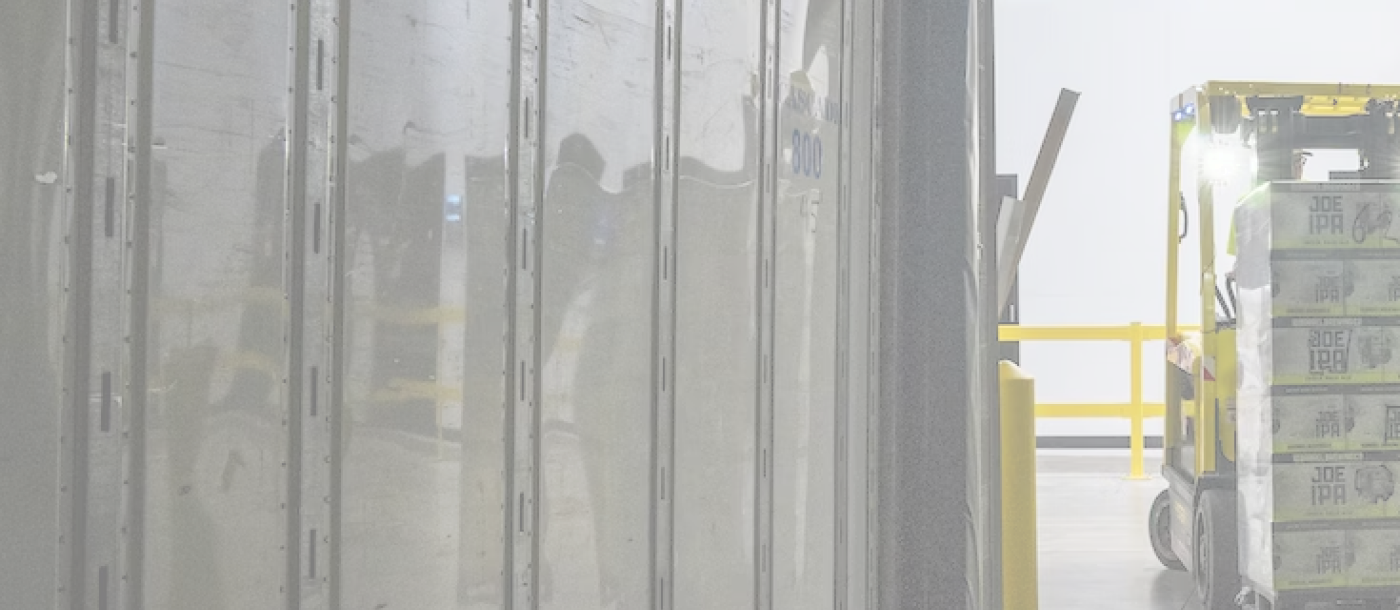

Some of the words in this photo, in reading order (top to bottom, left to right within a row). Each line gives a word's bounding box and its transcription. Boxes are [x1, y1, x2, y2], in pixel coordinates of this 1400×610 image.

[791, 128, 823, 179] 800
[1309, 195, 1343, 212] JOE
[1309, 214, 1344, 235] IPA
[1315, 276, 1340, 288] JOE
[1315, 289, 1340, 303] IPA
[1310, 331, 1345, 347] JOE
[1310, 349, 1346, 371] IPA
[1315, 411, 1340, 422] JOE
[1315, 423, 1340, 438] IPA
[1312, 466, 1345, 483] JOE
[1312, 484, 1346, 506] IPA
[1317, 559, 1341, 575] IPA
